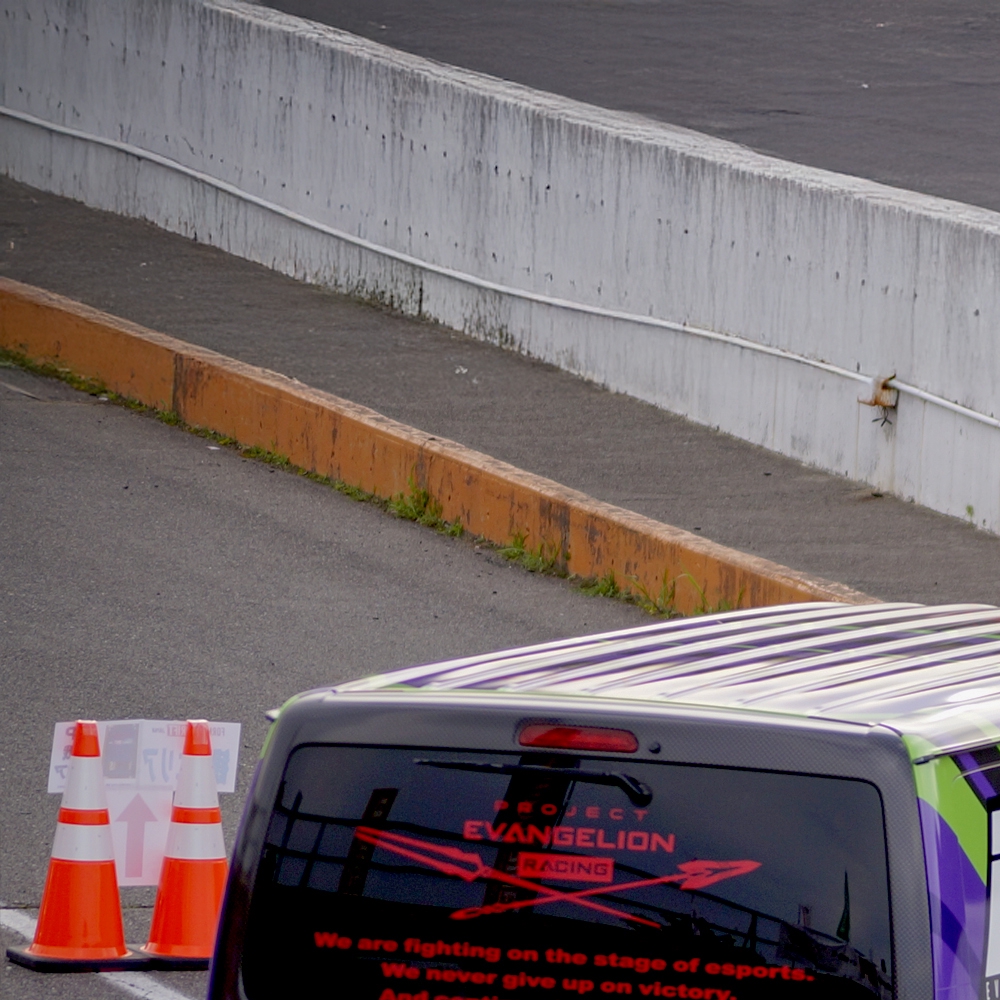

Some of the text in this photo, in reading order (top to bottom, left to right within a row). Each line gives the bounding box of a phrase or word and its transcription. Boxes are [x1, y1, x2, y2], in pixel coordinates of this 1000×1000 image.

[493, 799, 649, 822] PROJECT
[462, 820, 676, 853] EVANGELION
[523, 857, 608, 876] RACING
[314, 931, 815, 982] We are fighting on the stage of esports.
[381, 961, 420, 980] We
[425, 968, 498, 984] never
[502, 972, 556, 990] give
[562, 977, 594, 994] up
[600, 980, 632, 994] on
